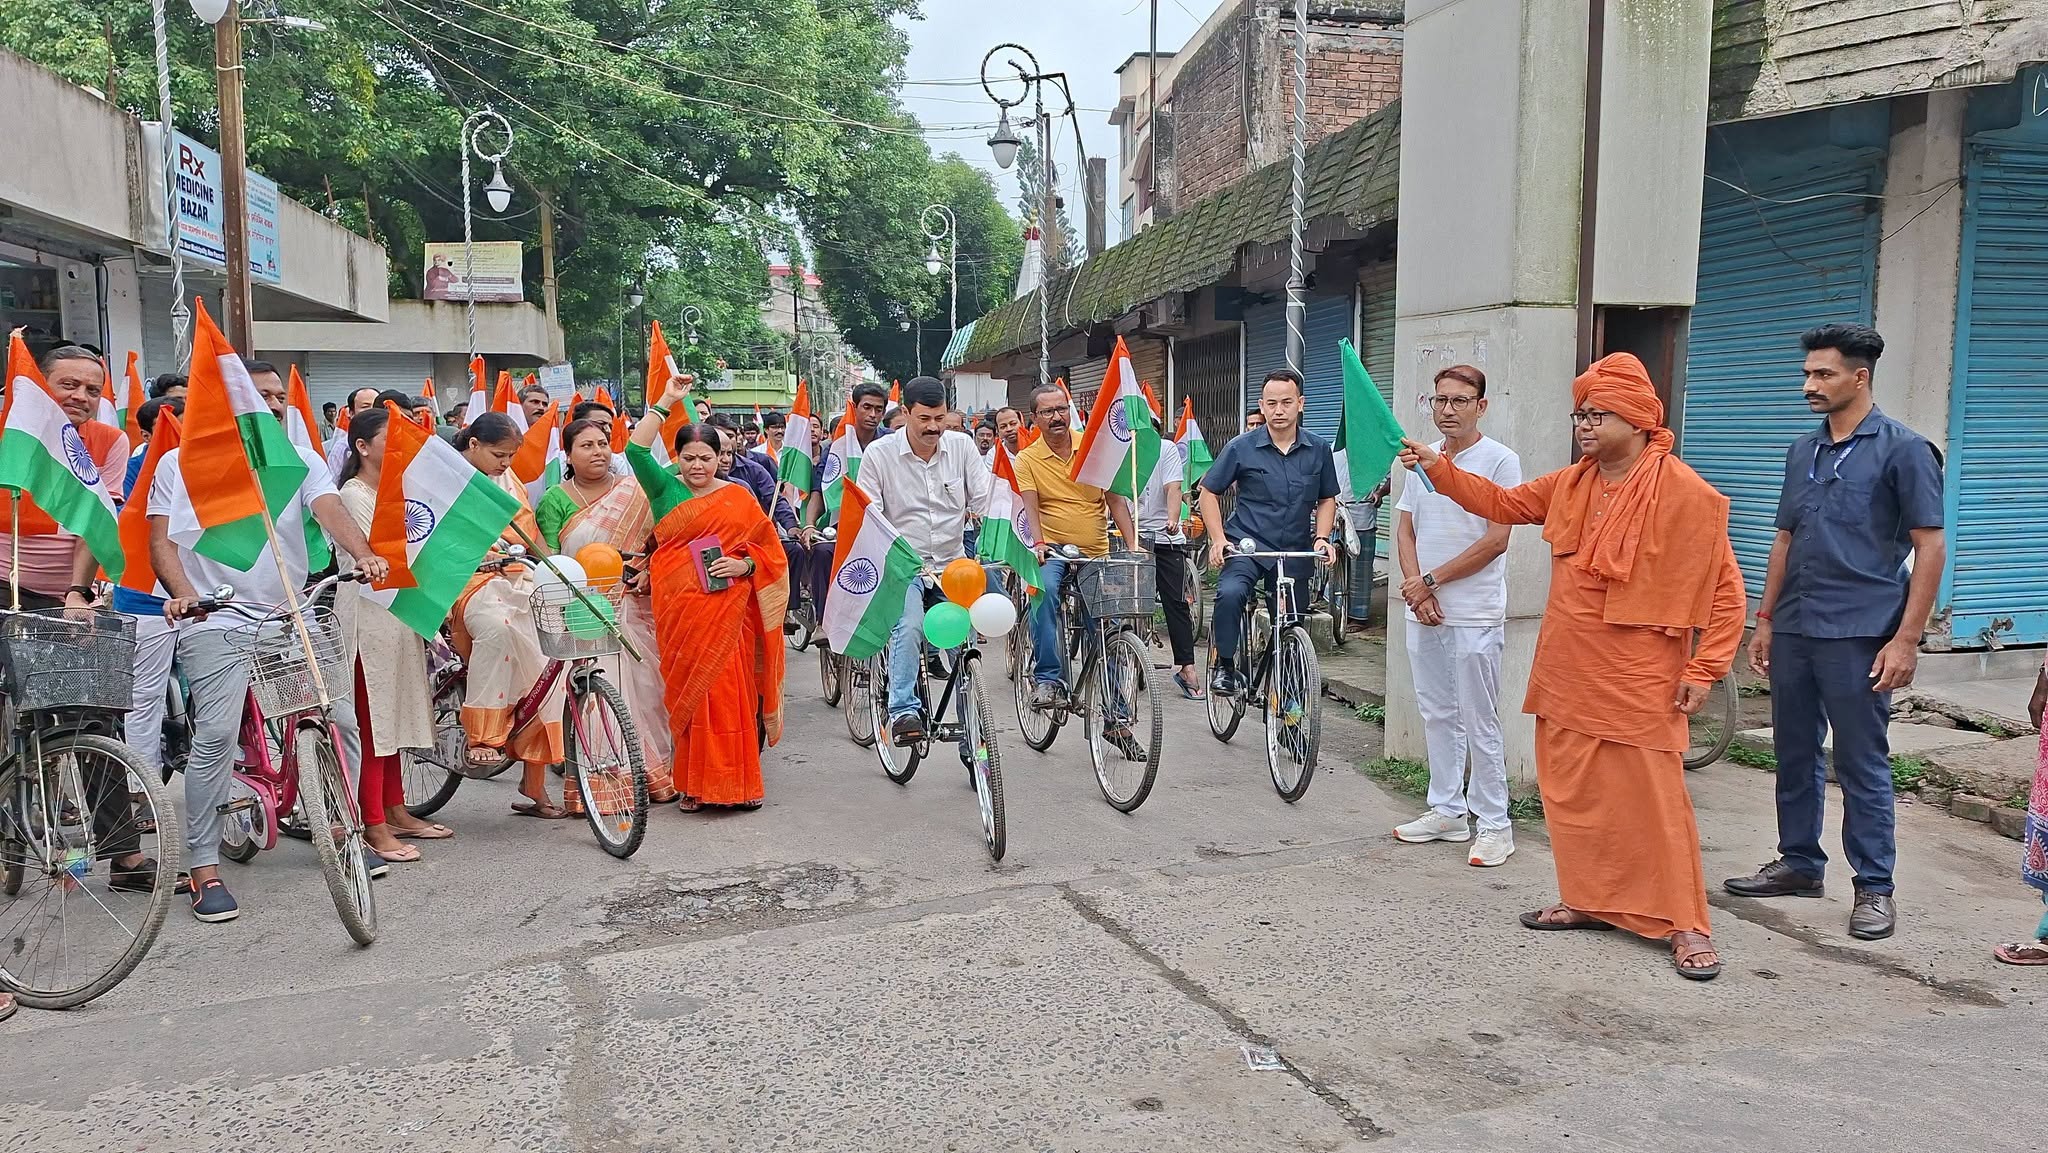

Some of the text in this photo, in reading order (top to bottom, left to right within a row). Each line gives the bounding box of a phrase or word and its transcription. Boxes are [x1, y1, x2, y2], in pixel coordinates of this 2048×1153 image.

[179, 143, 206, 181] Rx
[175, 173, 214, 204] MEDICINE
[180, 196, 209, 224] BAZAR
